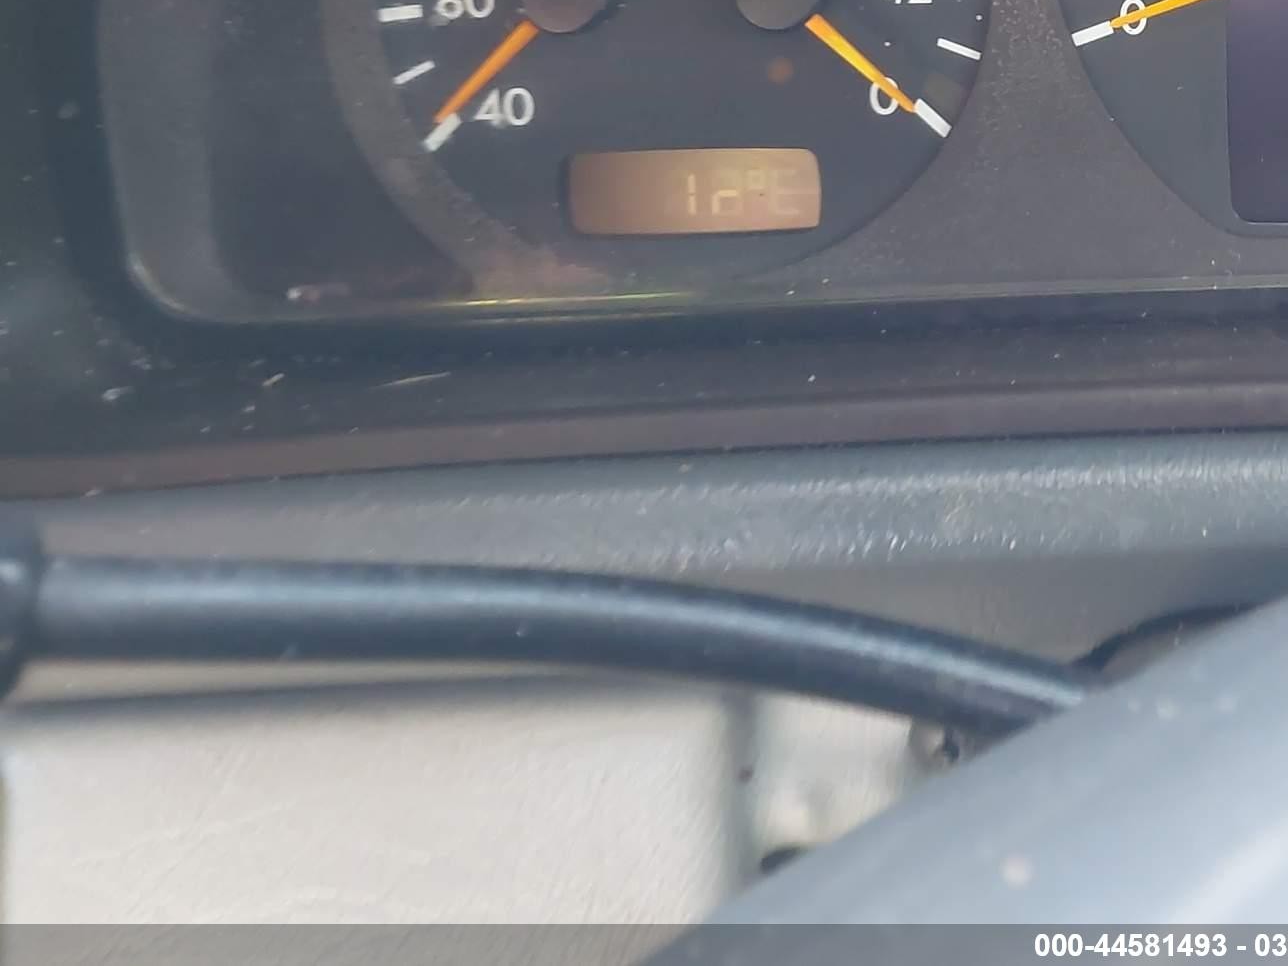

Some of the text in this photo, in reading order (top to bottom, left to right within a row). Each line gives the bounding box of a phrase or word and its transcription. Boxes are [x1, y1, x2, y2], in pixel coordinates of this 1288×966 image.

[1119, 0, 1148, 34] 0
[474, 87, 533, 125] 40
[869, 77, 900, 114] 0
